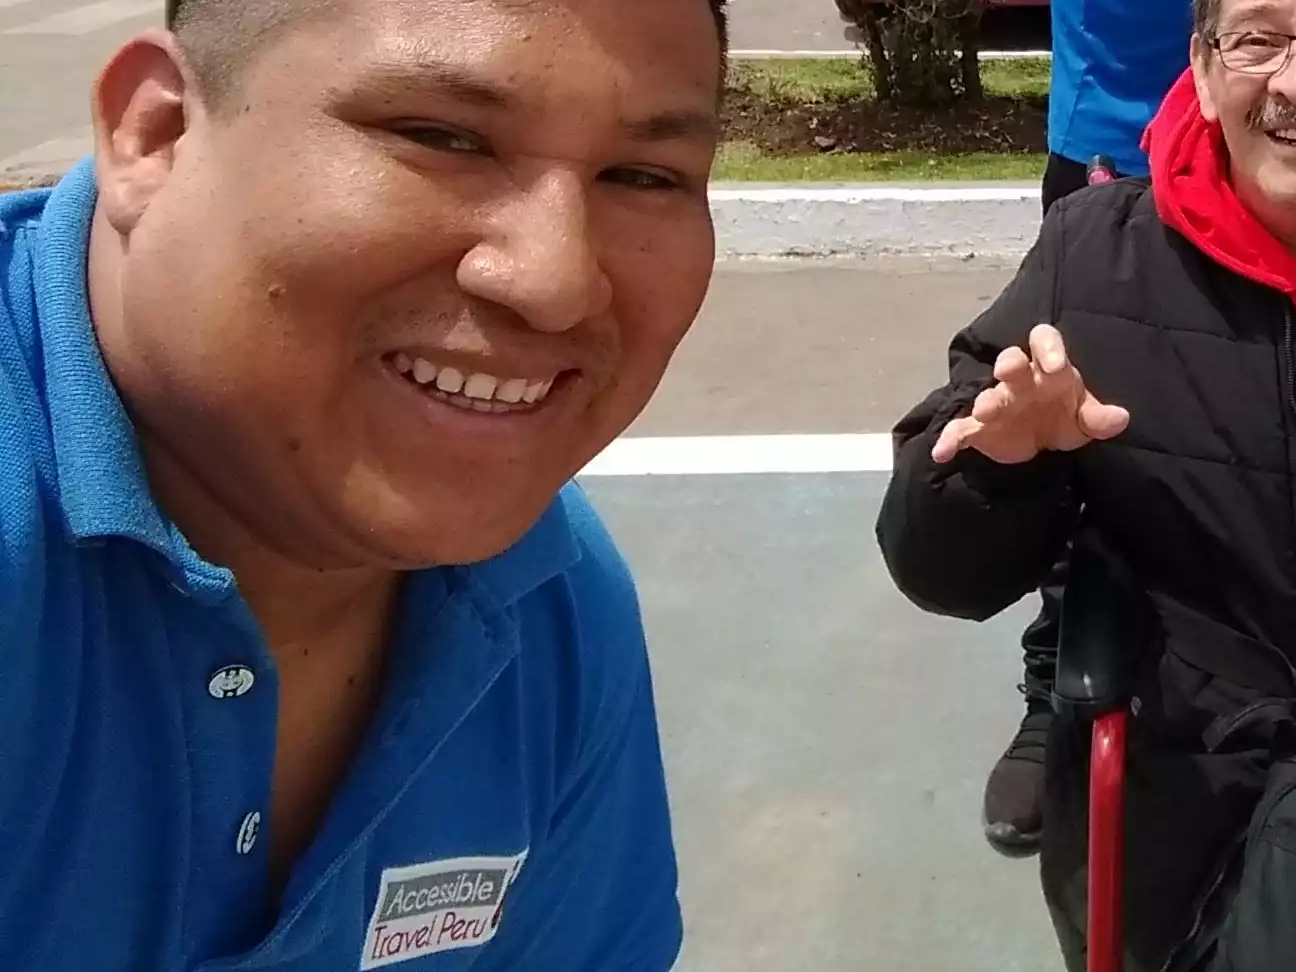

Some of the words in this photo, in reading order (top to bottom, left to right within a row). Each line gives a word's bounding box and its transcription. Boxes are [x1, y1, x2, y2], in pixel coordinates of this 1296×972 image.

[386, 872, 494, 916] Accessible
[371, 914, 438, 961] Travel
[438, 911, 489, 946] Peru
